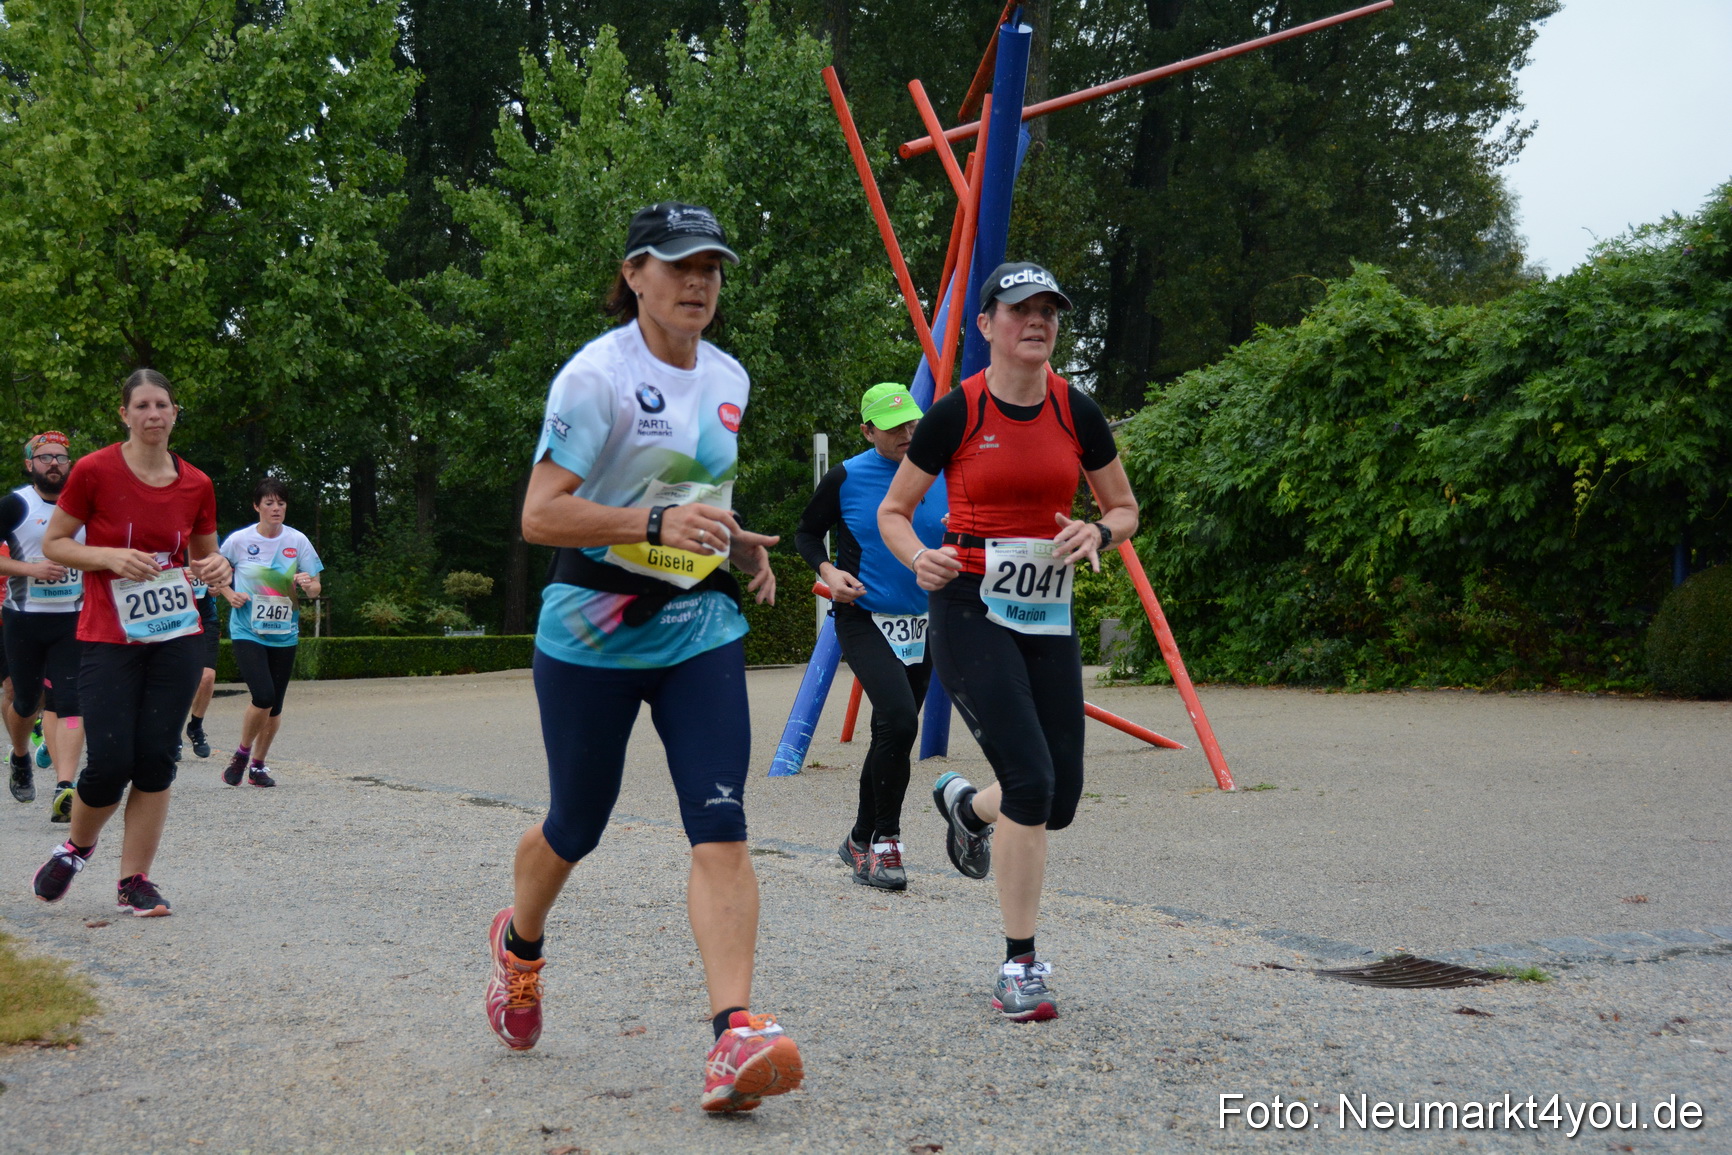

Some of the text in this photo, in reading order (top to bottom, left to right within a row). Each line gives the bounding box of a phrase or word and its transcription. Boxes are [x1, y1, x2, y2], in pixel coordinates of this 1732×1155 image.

[1000, 269, 1059, 292] adida
[639, 419, 673, 430] PARTL
[637, 429, 673, 438] Neumarkt
[648, 548, 694, 573] Gisela
[992, 561, 1067, 598] 2041
[43, 589, 73, 597] Thomas
[125, 585, 188, 620] 2035
[256, 604, 289, 620] 2467
[1006, 604, 1046, 621] Marion
[147, 619, 182, 634] Sabine
